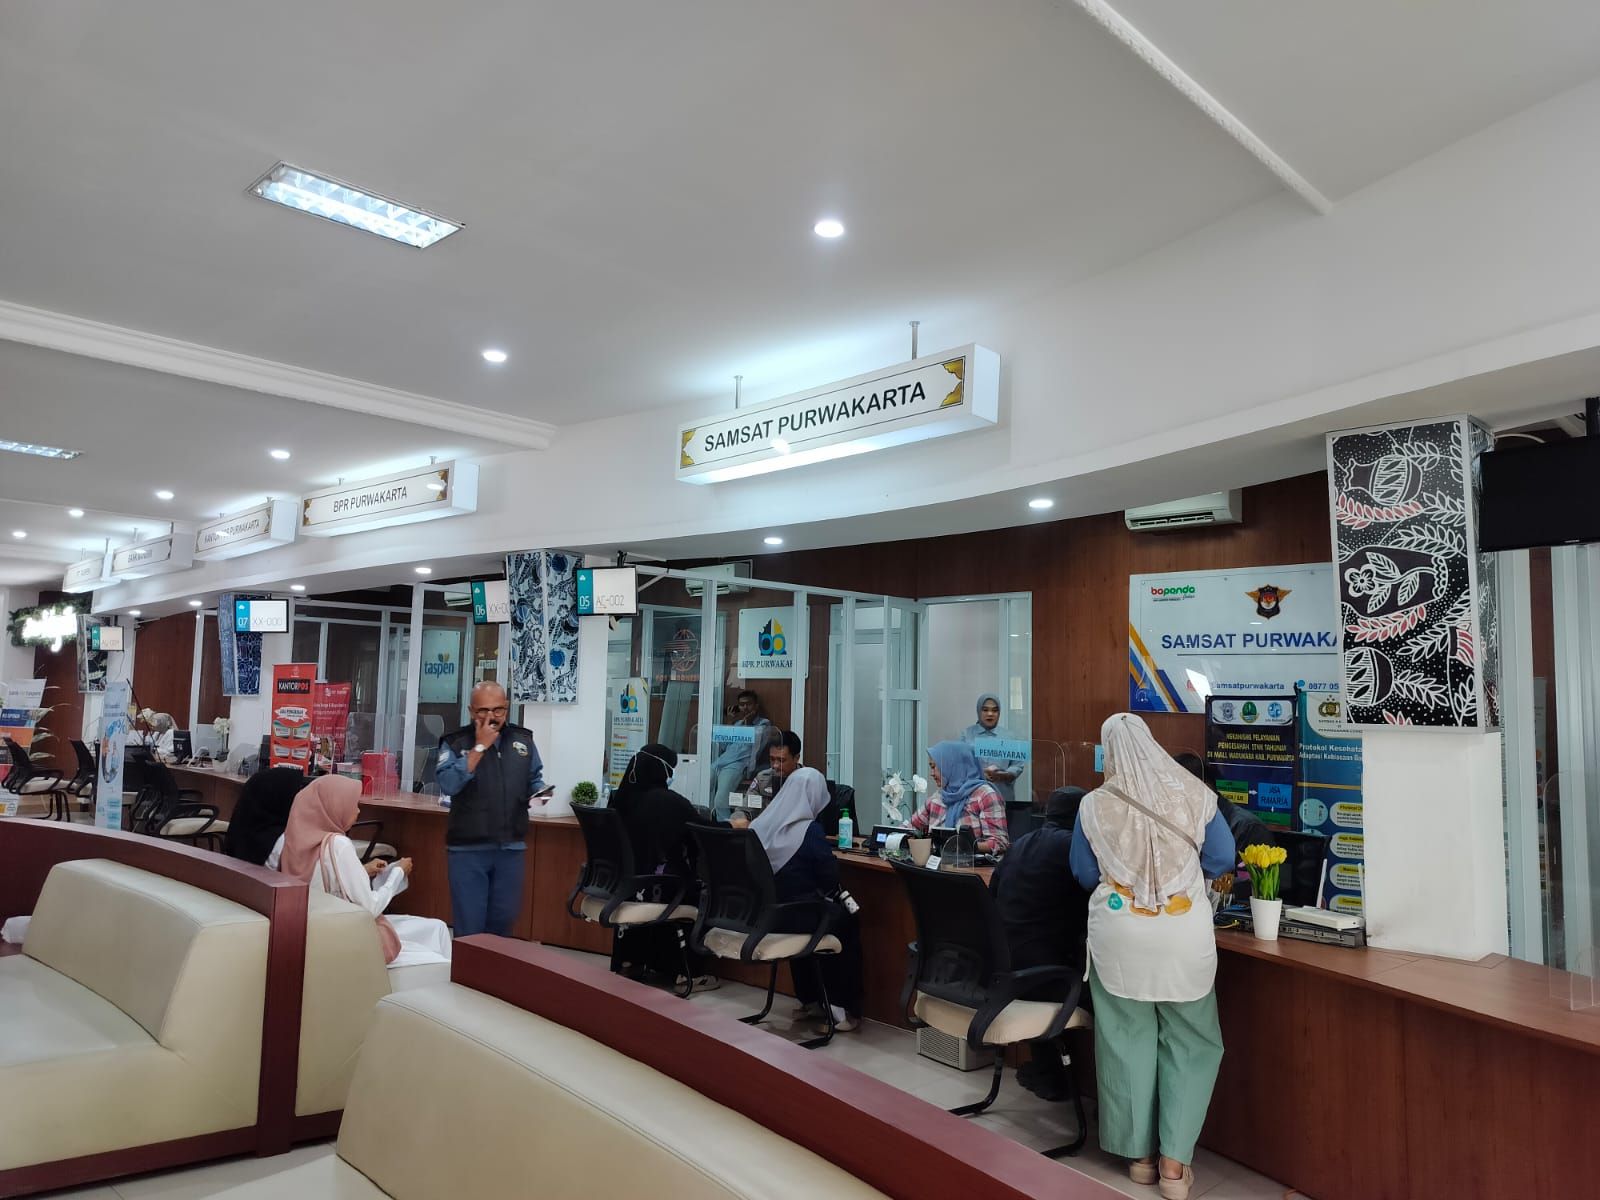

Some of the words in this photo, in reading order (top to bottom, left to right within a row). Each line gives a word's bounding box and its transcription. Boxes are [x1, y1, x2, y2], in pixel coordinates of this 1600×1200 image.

[704, 419, 773, 452] SAMSAT
[777, 381, 927, 435] PURWAKARTA
[333, 498, 349, 513] BPR
[350, 486, 408, 511] PURWAKARTA
[580, 595, 590, 607] 05
[475, 604, 486, 615] 06
[238, 617, 249, 626] 07
[1161, 633, 1237, 649] SAMSAT
[424, 660, 455, 680] taspen
[1212, 681, 1285, 691] amsatpurwakarta
[1299, 742, 1328, 751] Protokol
[979, 748, 1026, 760] PEMBAYARAN
